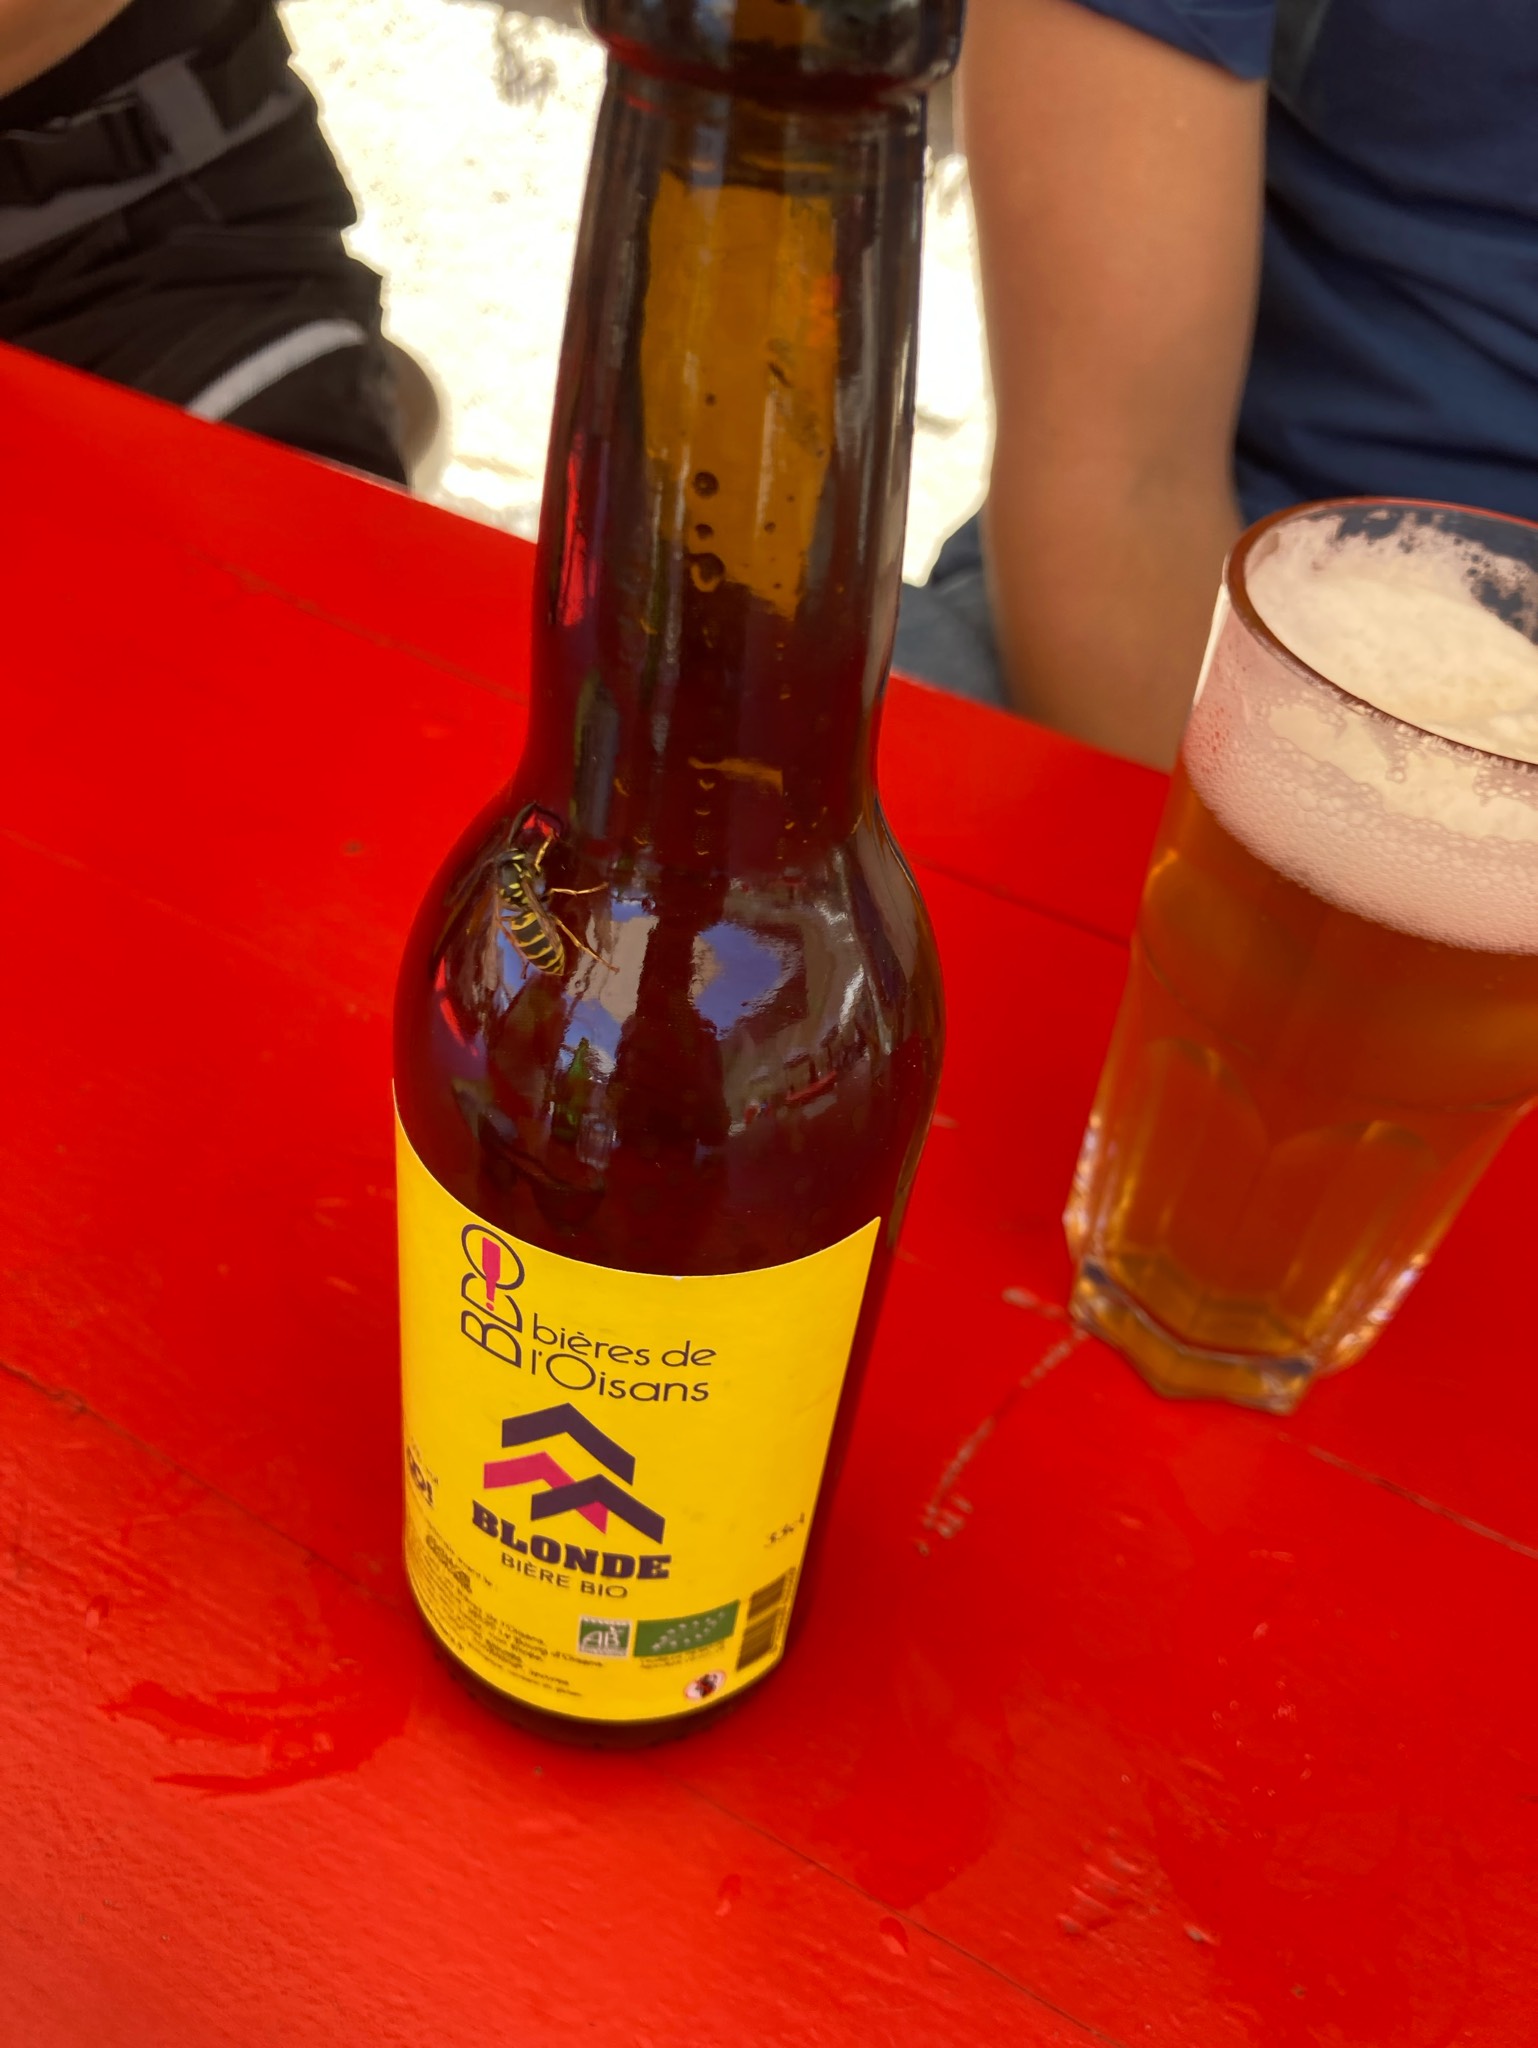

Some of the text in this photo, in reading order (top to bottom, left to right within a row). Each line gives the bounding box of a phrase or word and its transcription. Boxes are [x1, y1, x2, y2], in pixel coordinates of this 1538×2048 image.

[532, 1313, 717, 1368] bières de
[531, 1349, 709, 1402] l'Oisans
[472, 1500, 672, 1580] BLONDE
[501, 1552, 569, 1589] BIÈRE
[580, 1578, 628, 1599] BIO
